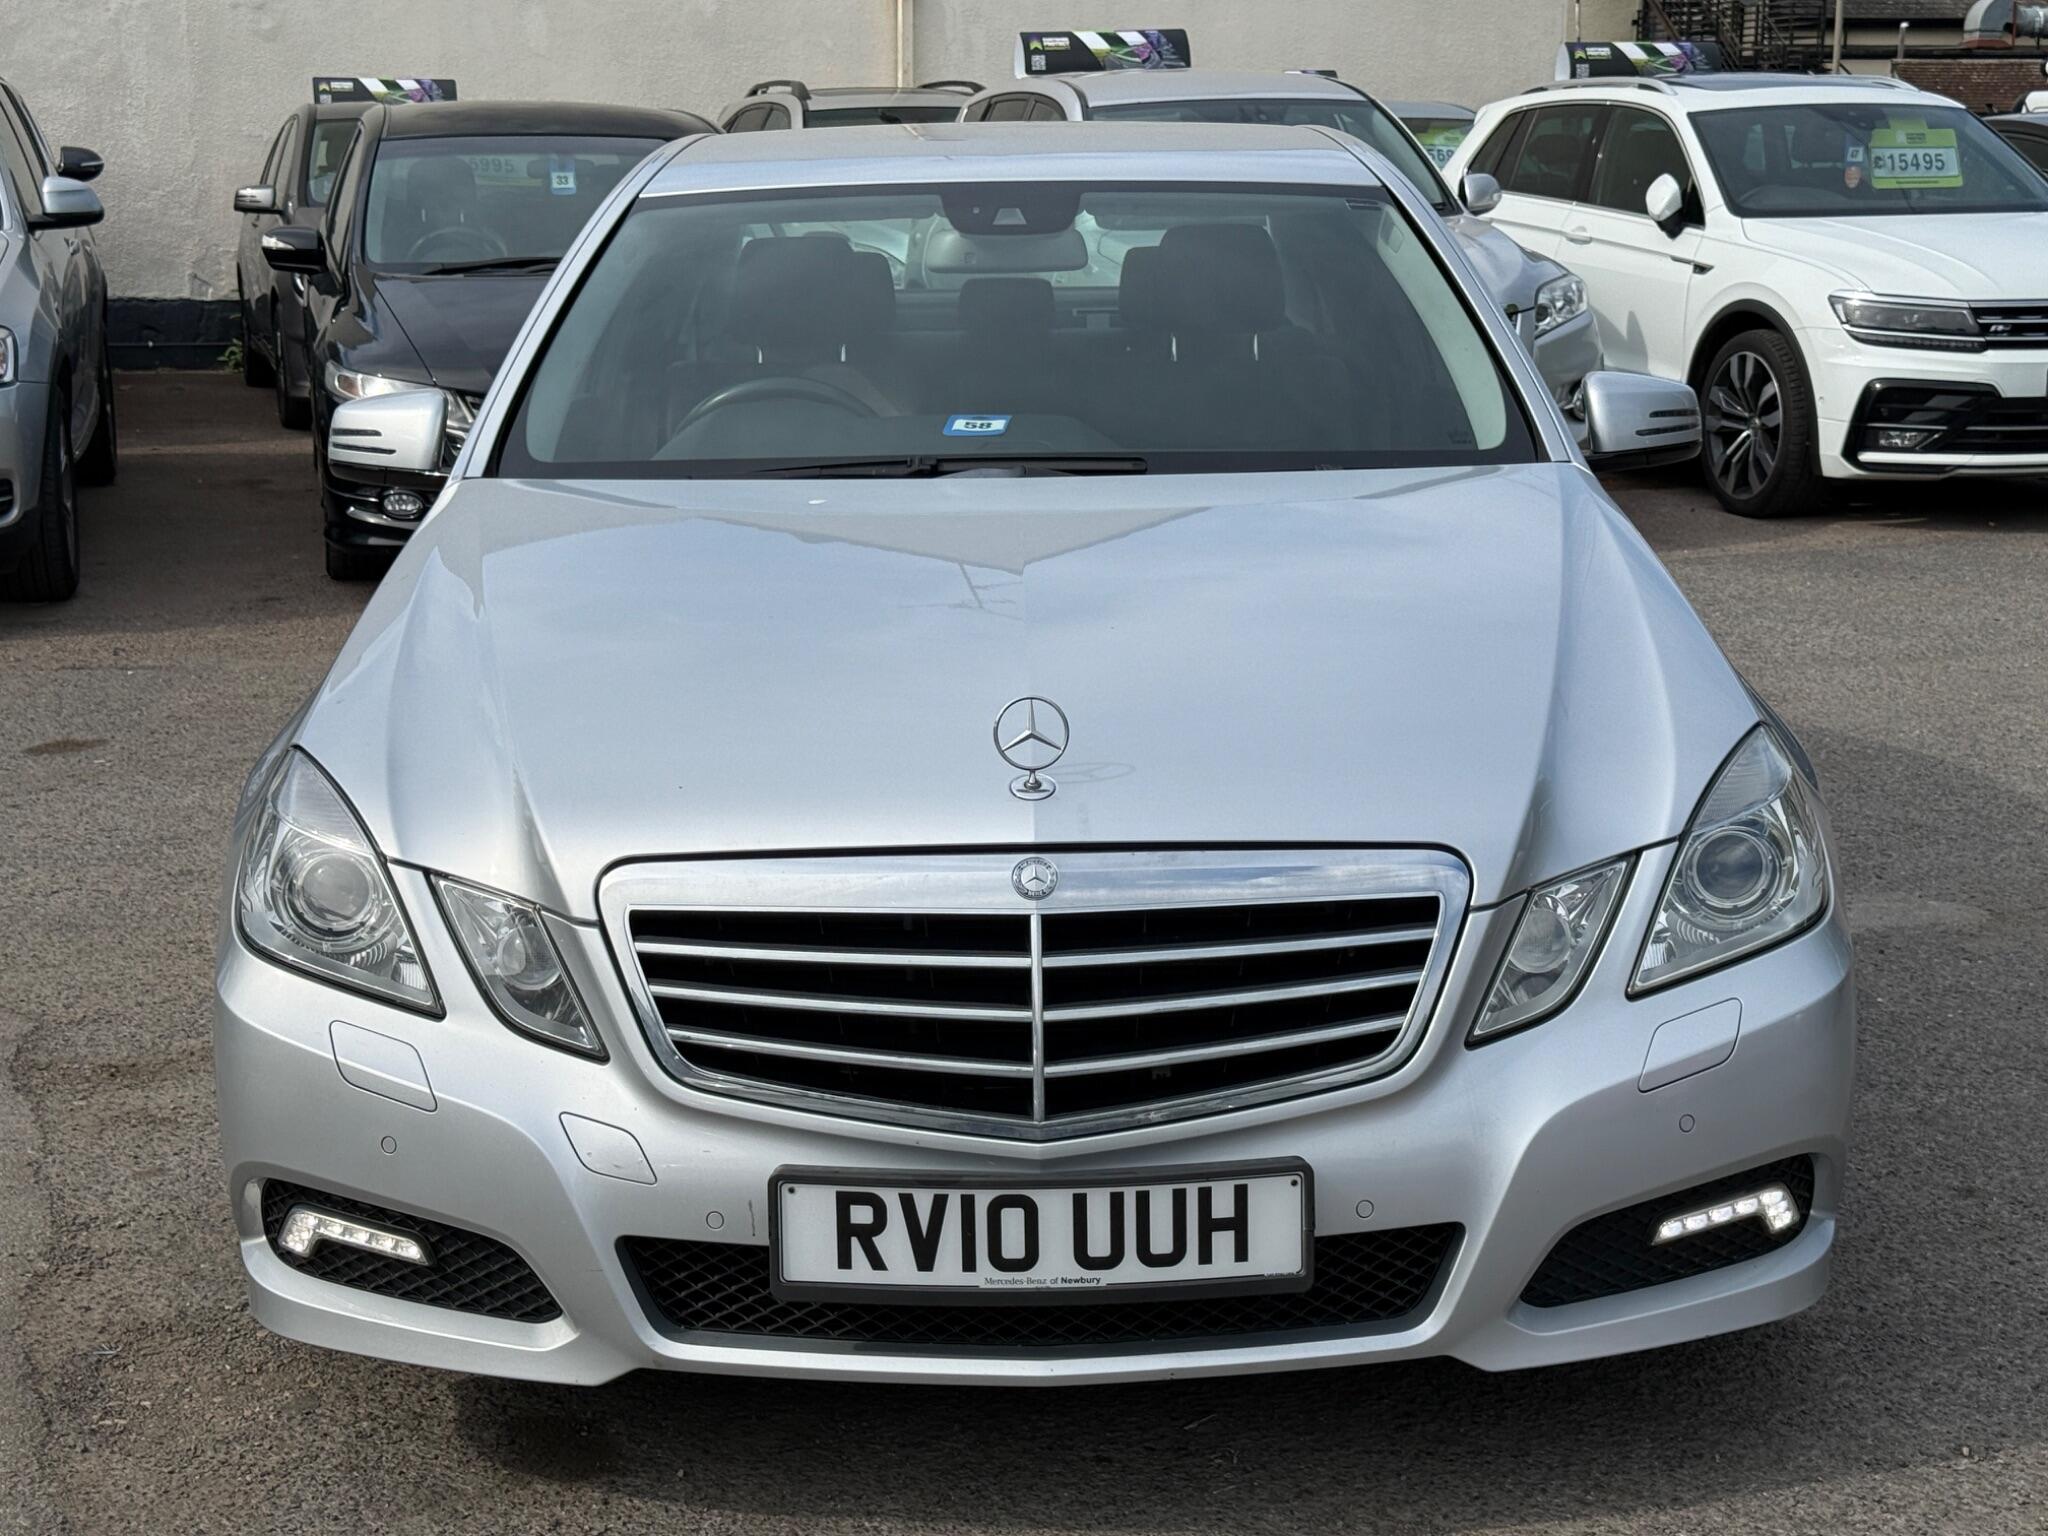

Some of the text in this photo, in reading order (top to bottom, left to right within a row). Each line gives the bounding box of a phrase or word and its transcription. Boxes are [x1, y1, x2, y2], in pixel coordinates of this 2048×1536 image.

[556, 175, 569, 185] 33
[836, 1184, 1248, 1273] RV10 UUH
[984, 1277, 1101, 1286] Mercedes-Benz of Newbury
